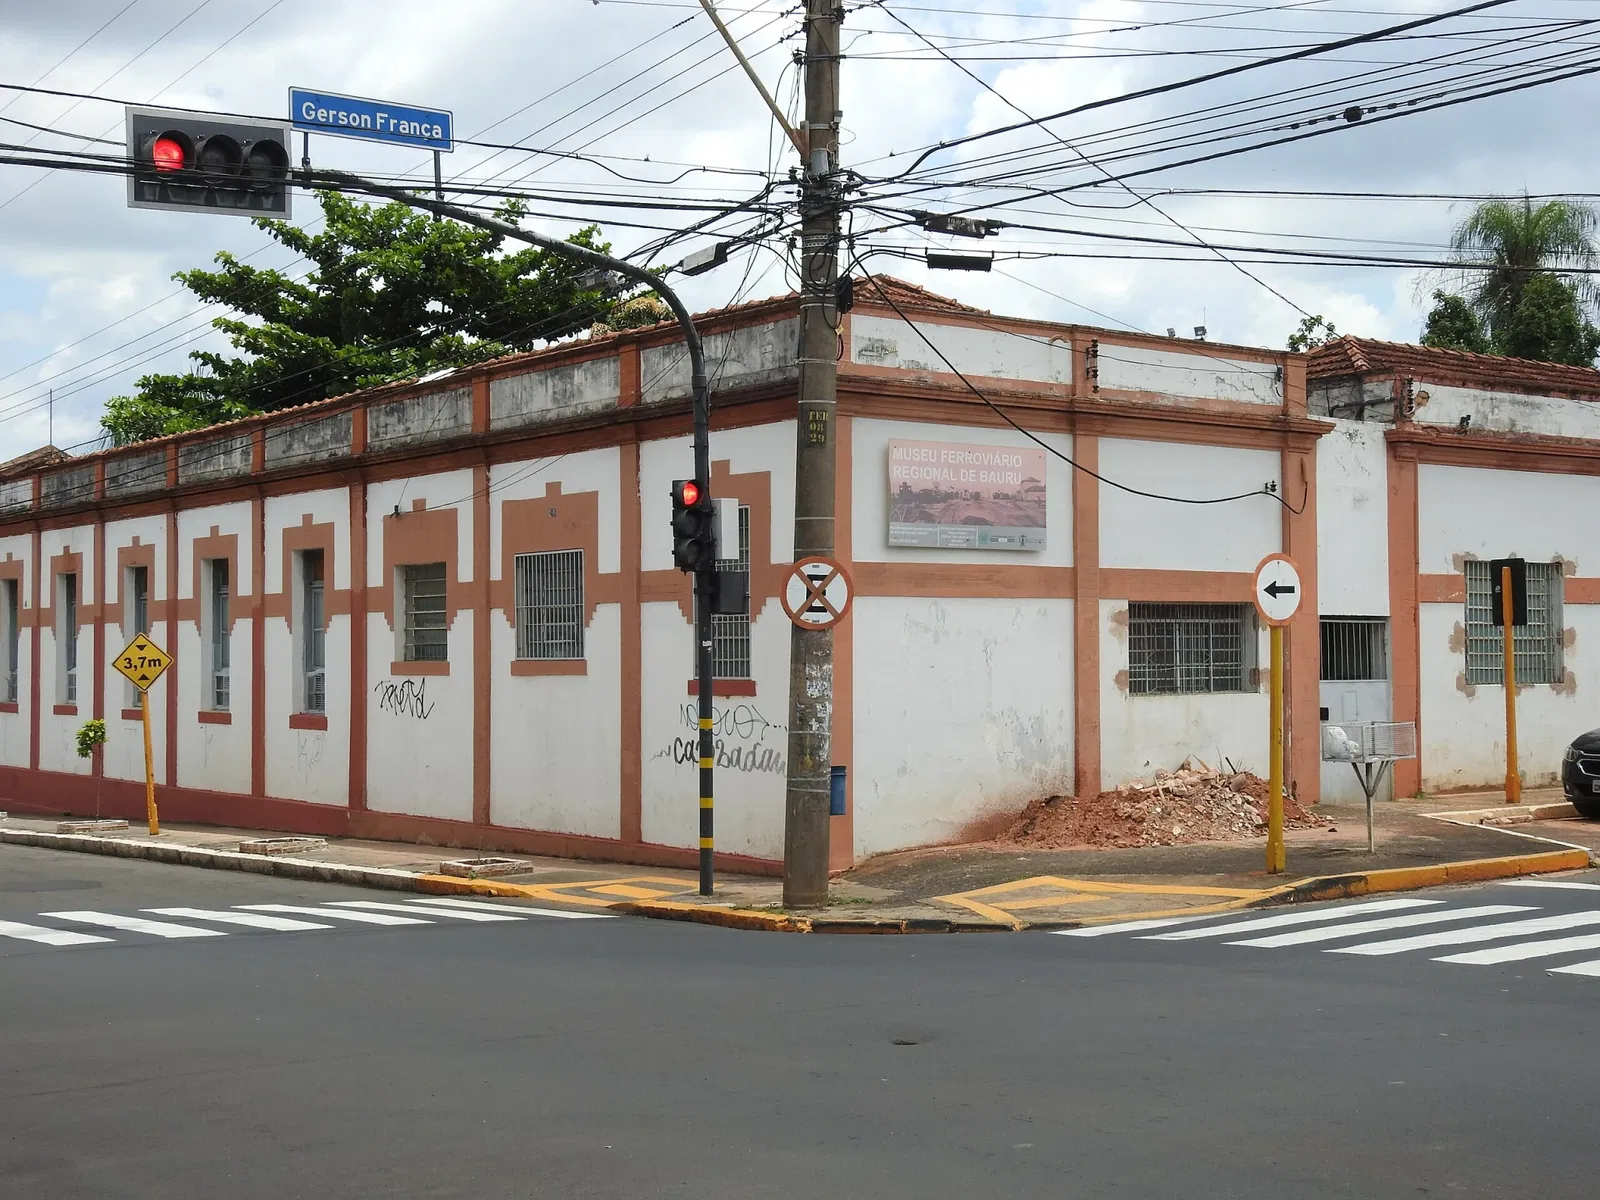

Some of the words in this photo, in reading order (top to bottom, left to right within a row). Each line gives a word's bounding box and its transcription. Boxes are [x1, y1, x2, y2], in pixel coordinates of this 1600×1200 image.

[302, 101, 371, 128] Gerson
[376, 112, 442, 141] França
[810, 433, 825, 443] 29
[892, 447, 937, 462] MUSEU
[941, 450, 1022, 468] FERROVIÁRIO
[893, 465, 957, 481] REGIONAL
[960, 469, 977, 482] DE
[980, 471, 1022, 485] BAURU
[123, 656, 162, 671] 3,7m
